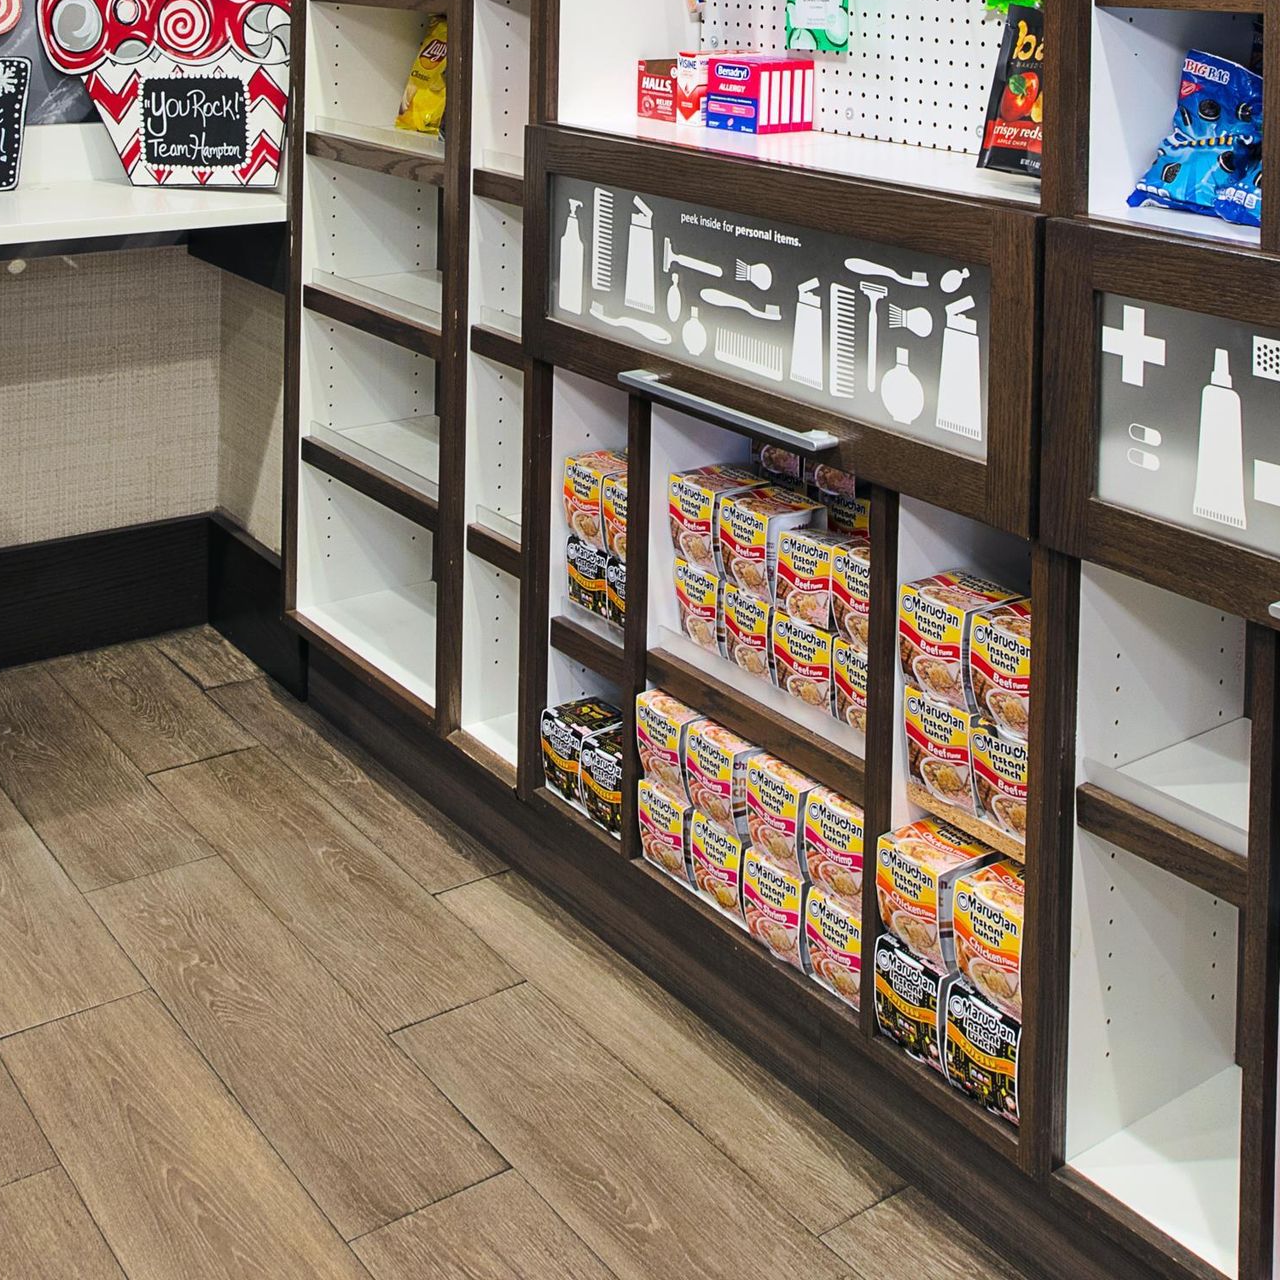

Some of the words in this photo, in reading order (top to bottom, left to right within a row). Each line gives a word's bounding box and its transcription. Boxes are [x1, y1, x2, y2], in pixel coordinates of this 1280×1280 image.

[678, 57, 697, 70] VISINE
[717, 65, 749, 81] Benadryl
[1183, 58, 1208, 76] BIG
[1206, 67, 1231, 85] BAG
[718, 83, 746, 93] ALLERGY
[148, 137, 190, 159] Team
[188, 133, 241, 165] Hampton
[680, 212, 699, 225] peek
[700, 215, 722, 231] inside
[722, 220, 735, 233] for
[735, 225, 773, 241] personal
[774, 230, 802, 247] items.
[788, 537, 829, 562] Maruchan
[790, 551, 819, 570] Instant
[912, 596, 960, 627] Maruchan
[914, 610, 946, 633] Instant
[917, 622, 943, 641] Lunch
[919, 639, 940, 656] Beef
[819, 803, 863, 837] Maruchan
[825, 848, 853, 867] Shrimp
[969, 936, 1003, 963] Chicken
